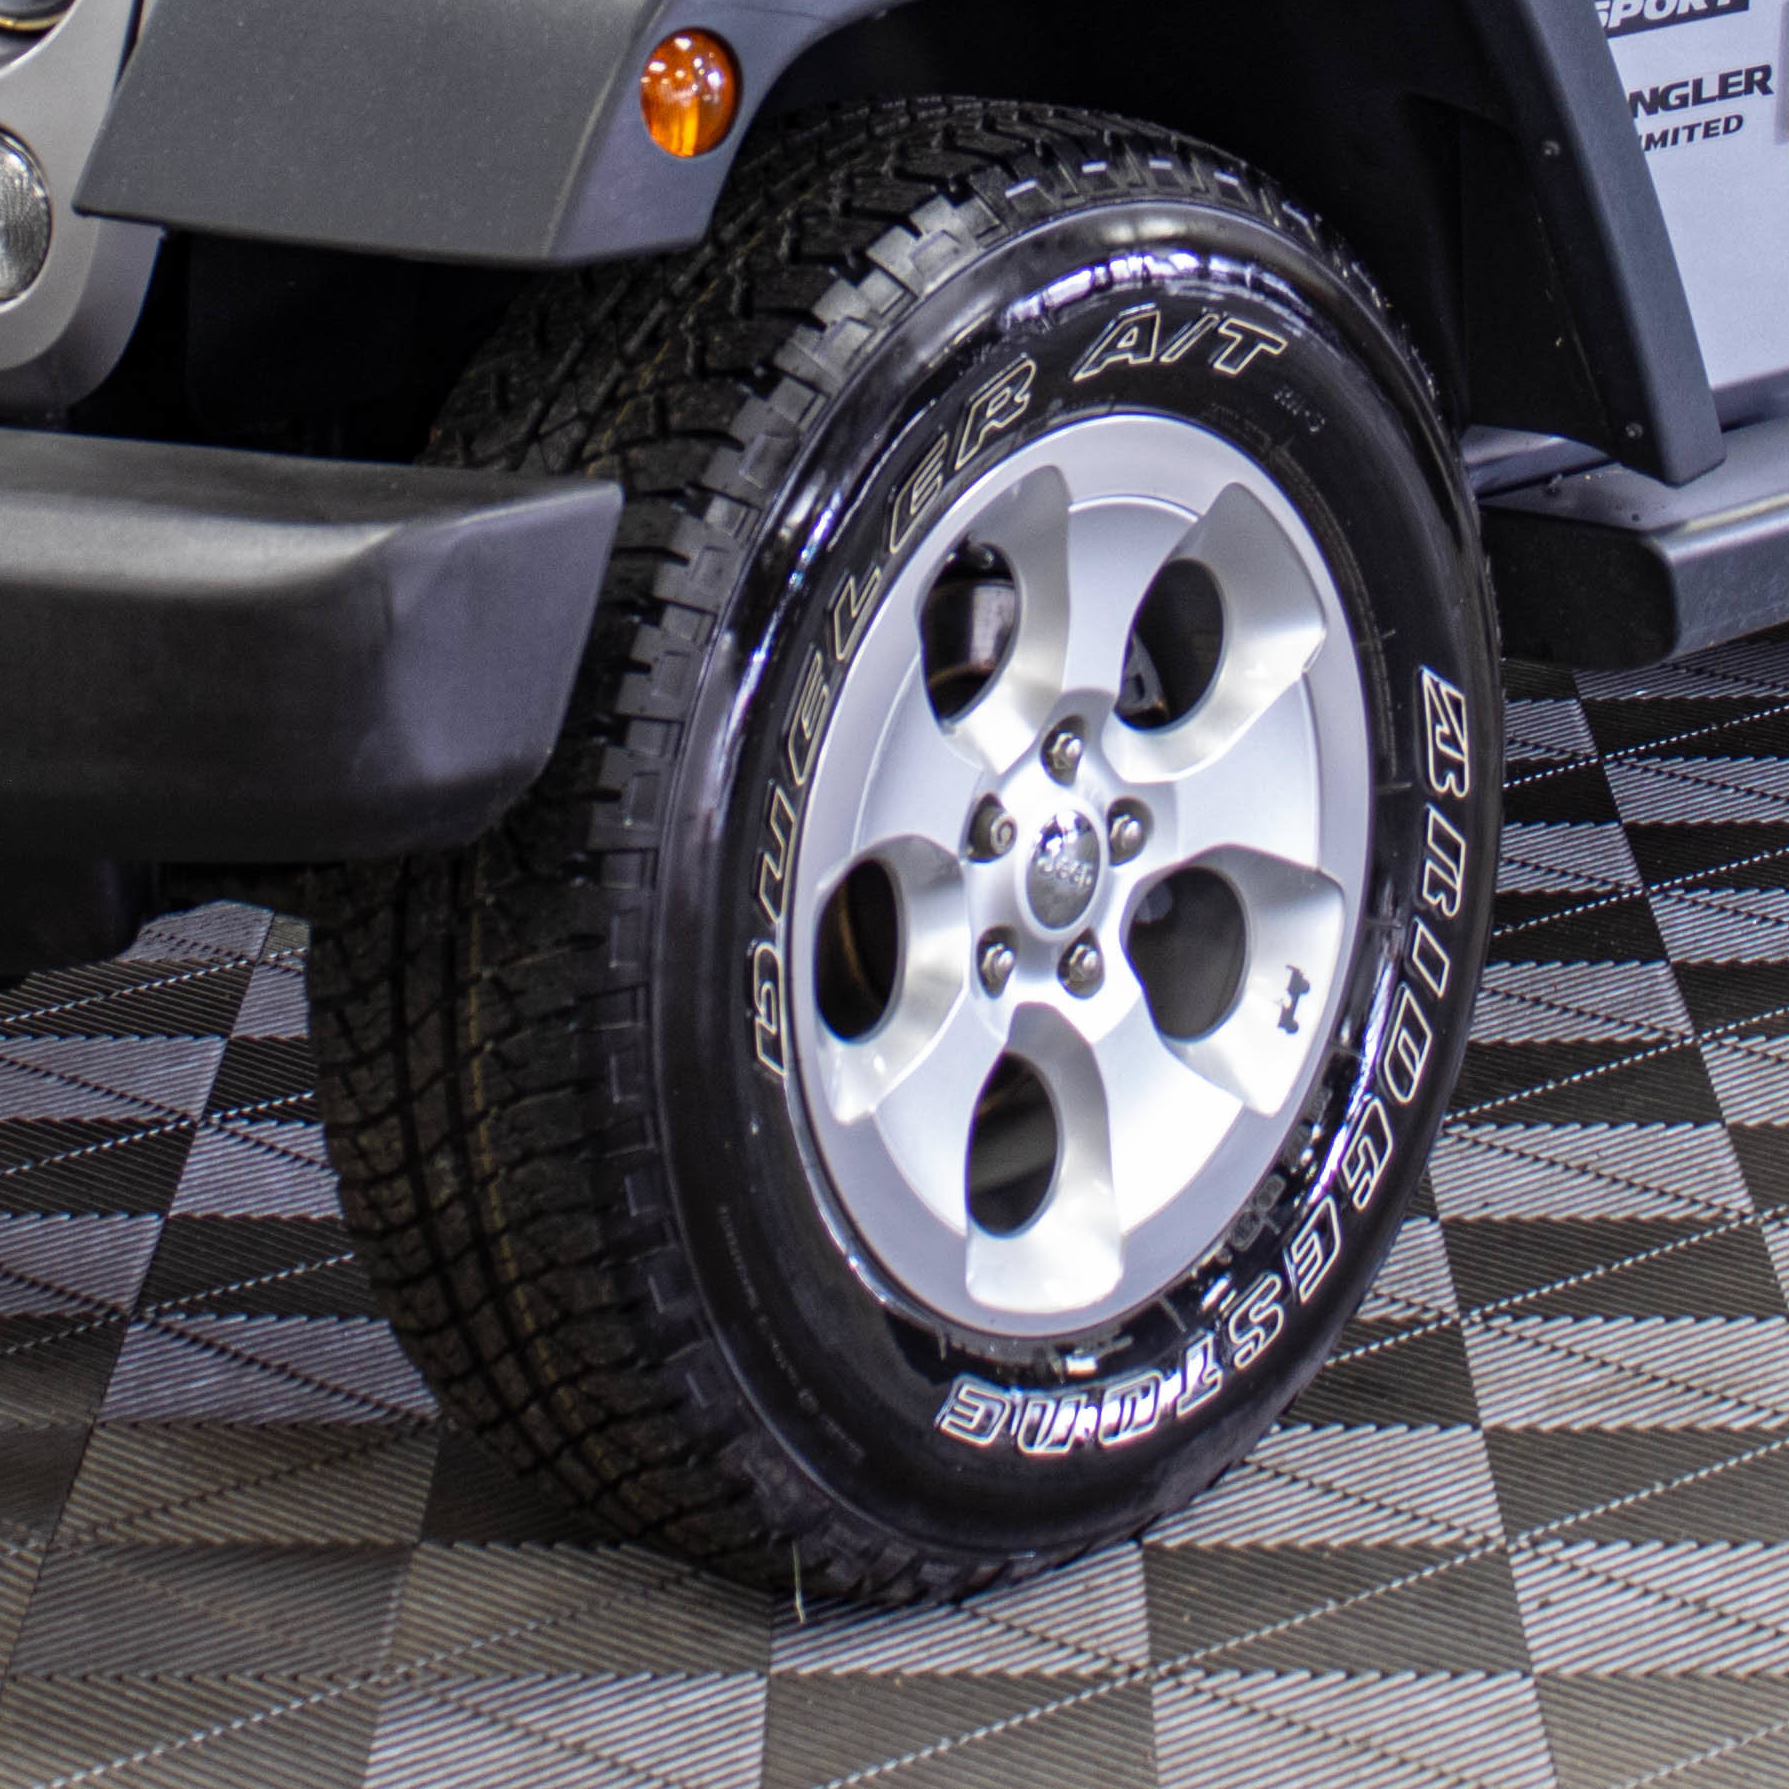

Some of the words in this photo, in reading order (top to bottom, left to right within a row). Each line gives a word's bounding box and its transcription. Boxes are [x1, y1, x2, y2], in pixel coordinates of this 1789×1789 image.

[1627, 64, 1774, 118] NGLER
[1637, 113, 1744, 152] MITED
[753, 357, 1037, 1076] DUELER
[1073, 307, 1287, 384] A/T
[936, 667, 1472, 1454] BRIDGESTONE
